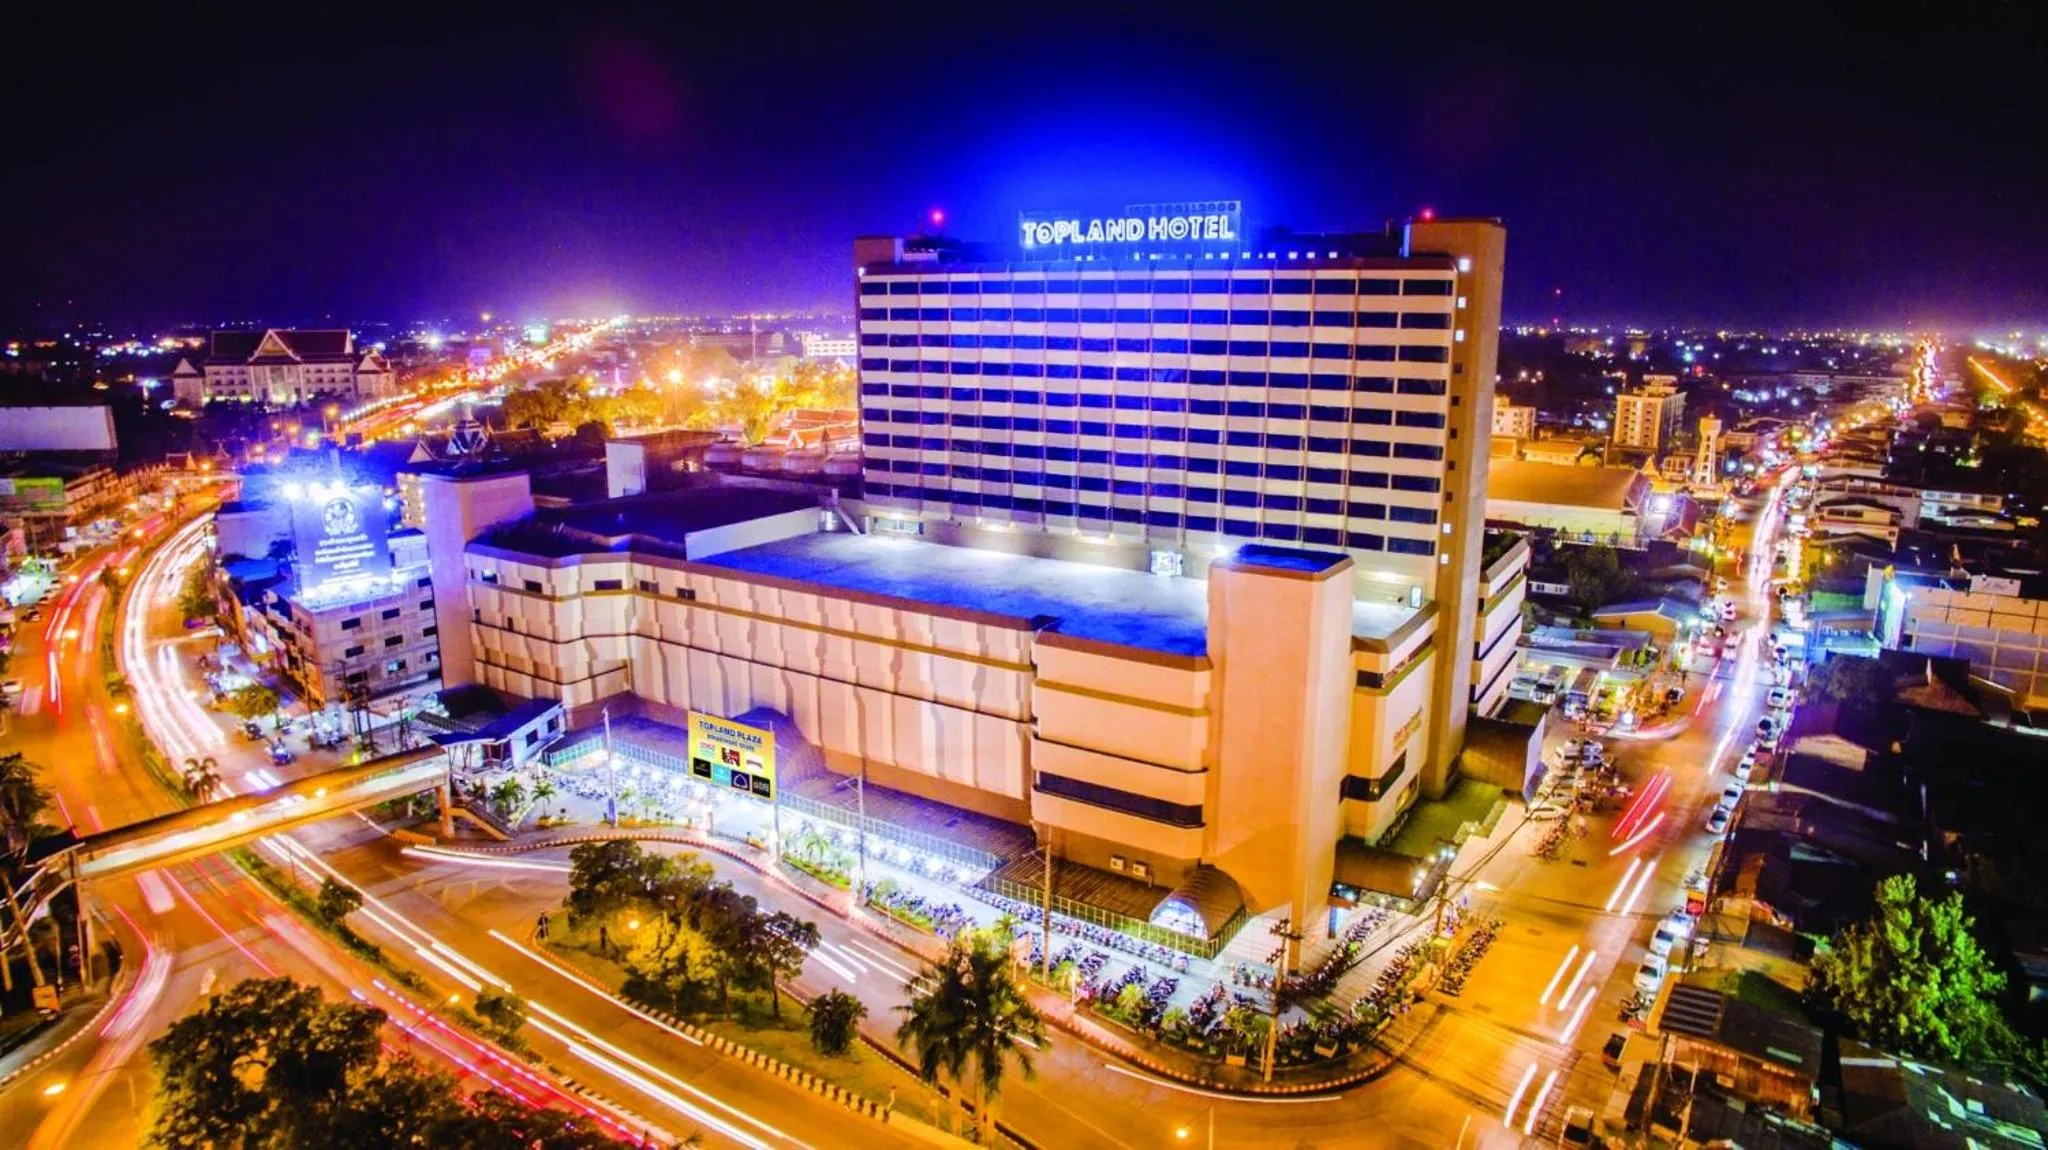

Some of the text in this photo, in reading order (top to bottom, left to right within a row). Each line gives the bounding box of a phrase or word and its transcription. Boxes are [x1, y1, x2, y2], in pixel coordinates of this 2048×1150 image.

[1022, 215, 1235, 247] TOPLAND HOTEL
[699, 721, 763, 744] TOPLAND PLAZA
